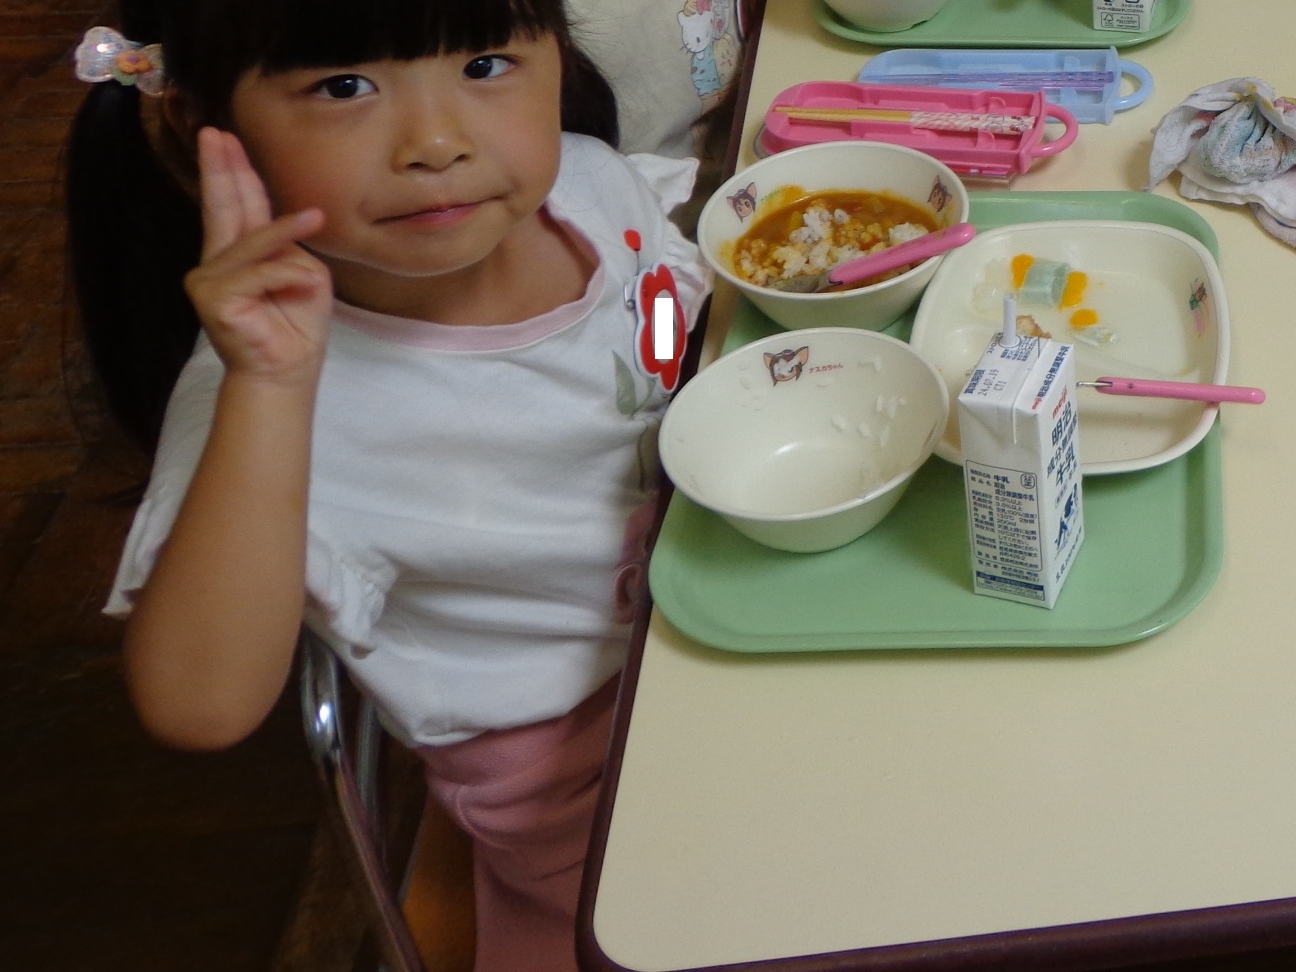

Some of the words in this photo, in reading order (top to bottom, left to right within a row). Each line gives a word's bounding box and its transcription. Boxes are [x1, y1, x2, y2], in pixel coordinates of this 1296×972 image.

[1037, 346, 1070, 398] 明治成分無調整牛乳
[1051, 401, 1071, 446] 明治
[1052, 385, 1067, 419] meiji
[994, 474, 1010, 483] 牛乳
[1056, 441, 1075, 488] 牛乳
